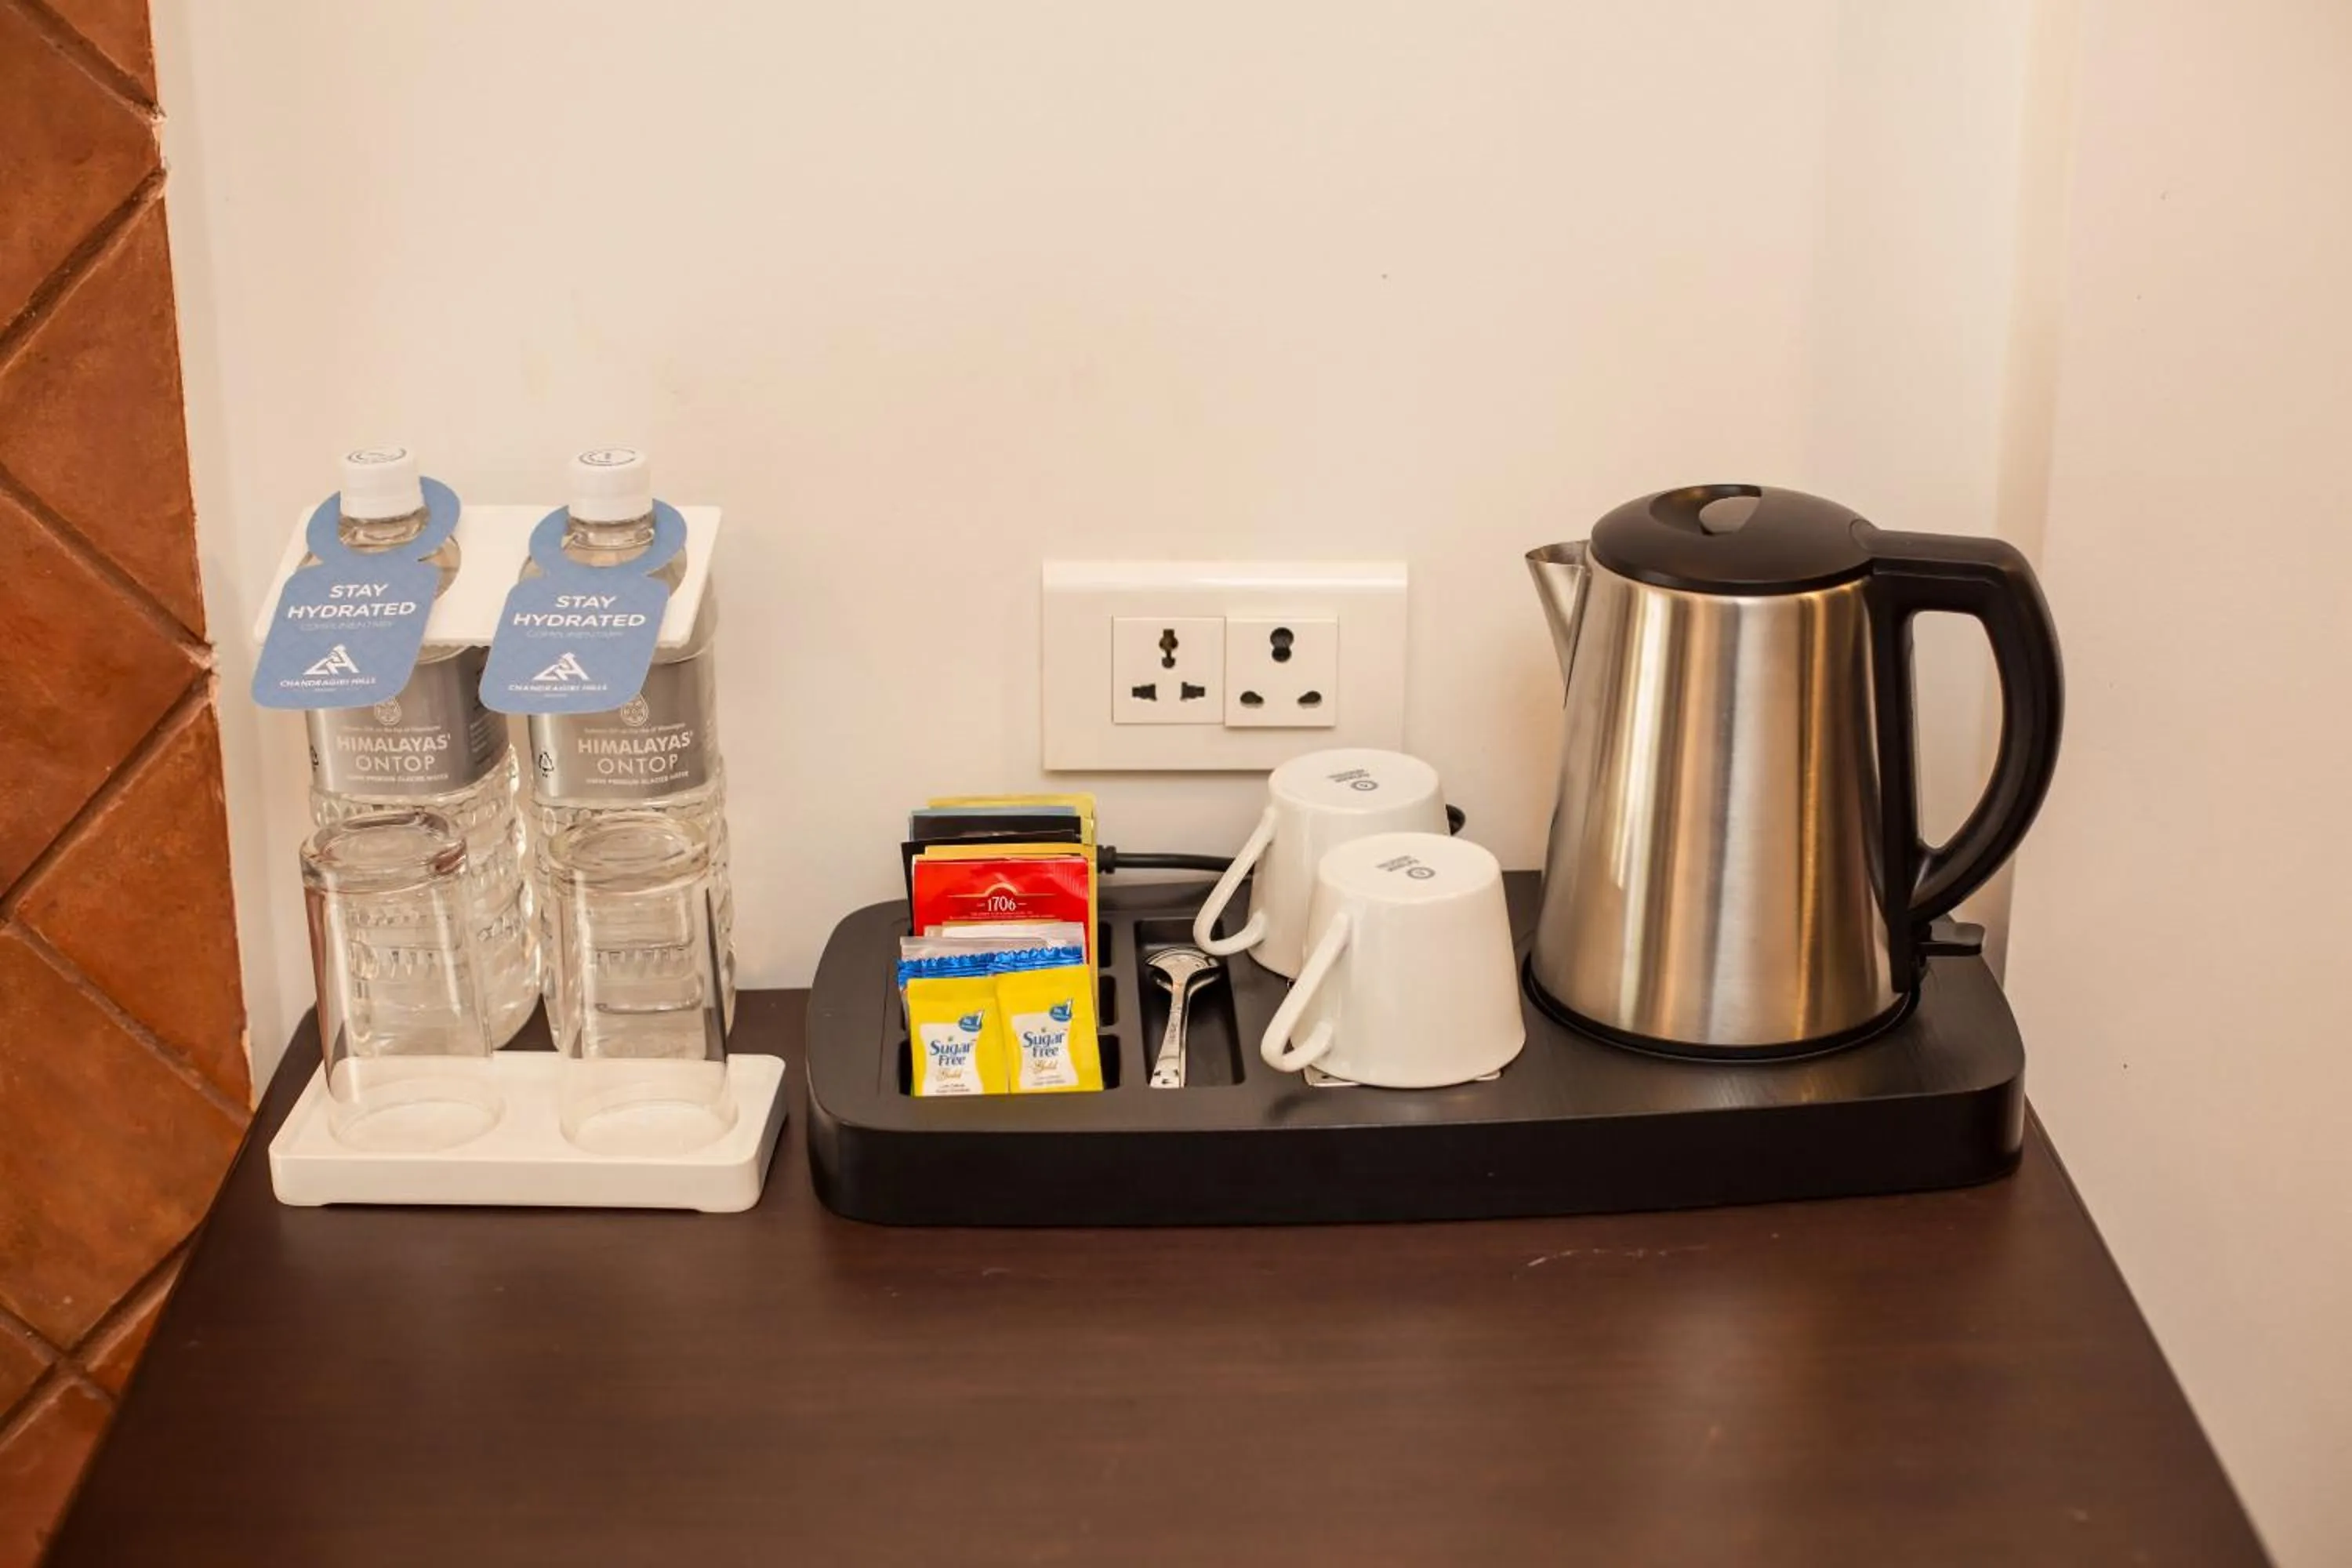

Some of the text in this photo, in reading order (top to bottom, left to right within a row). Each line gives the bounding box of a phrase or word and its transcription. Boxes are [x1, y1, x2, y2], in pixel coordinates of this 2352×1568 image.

[328, 583, 389, 598] STAY
[555, 595, 617, 608] STAY
[288, 601, 416, 619] HYDRATED
[514, 613, 646, 627] HYDRATED
[355, 755, 435, 772] ONTOP
[597, 753, 678, 775] ONTOP
[987, 895, 1016, 912] 1706
[1022, 1031, 1065, 1048] Sugar
[930, 1040, 972, 1056] Sugar
[1033, 1047, 1058, 1058] Free
[938, 1054, 966, 1066] Free
